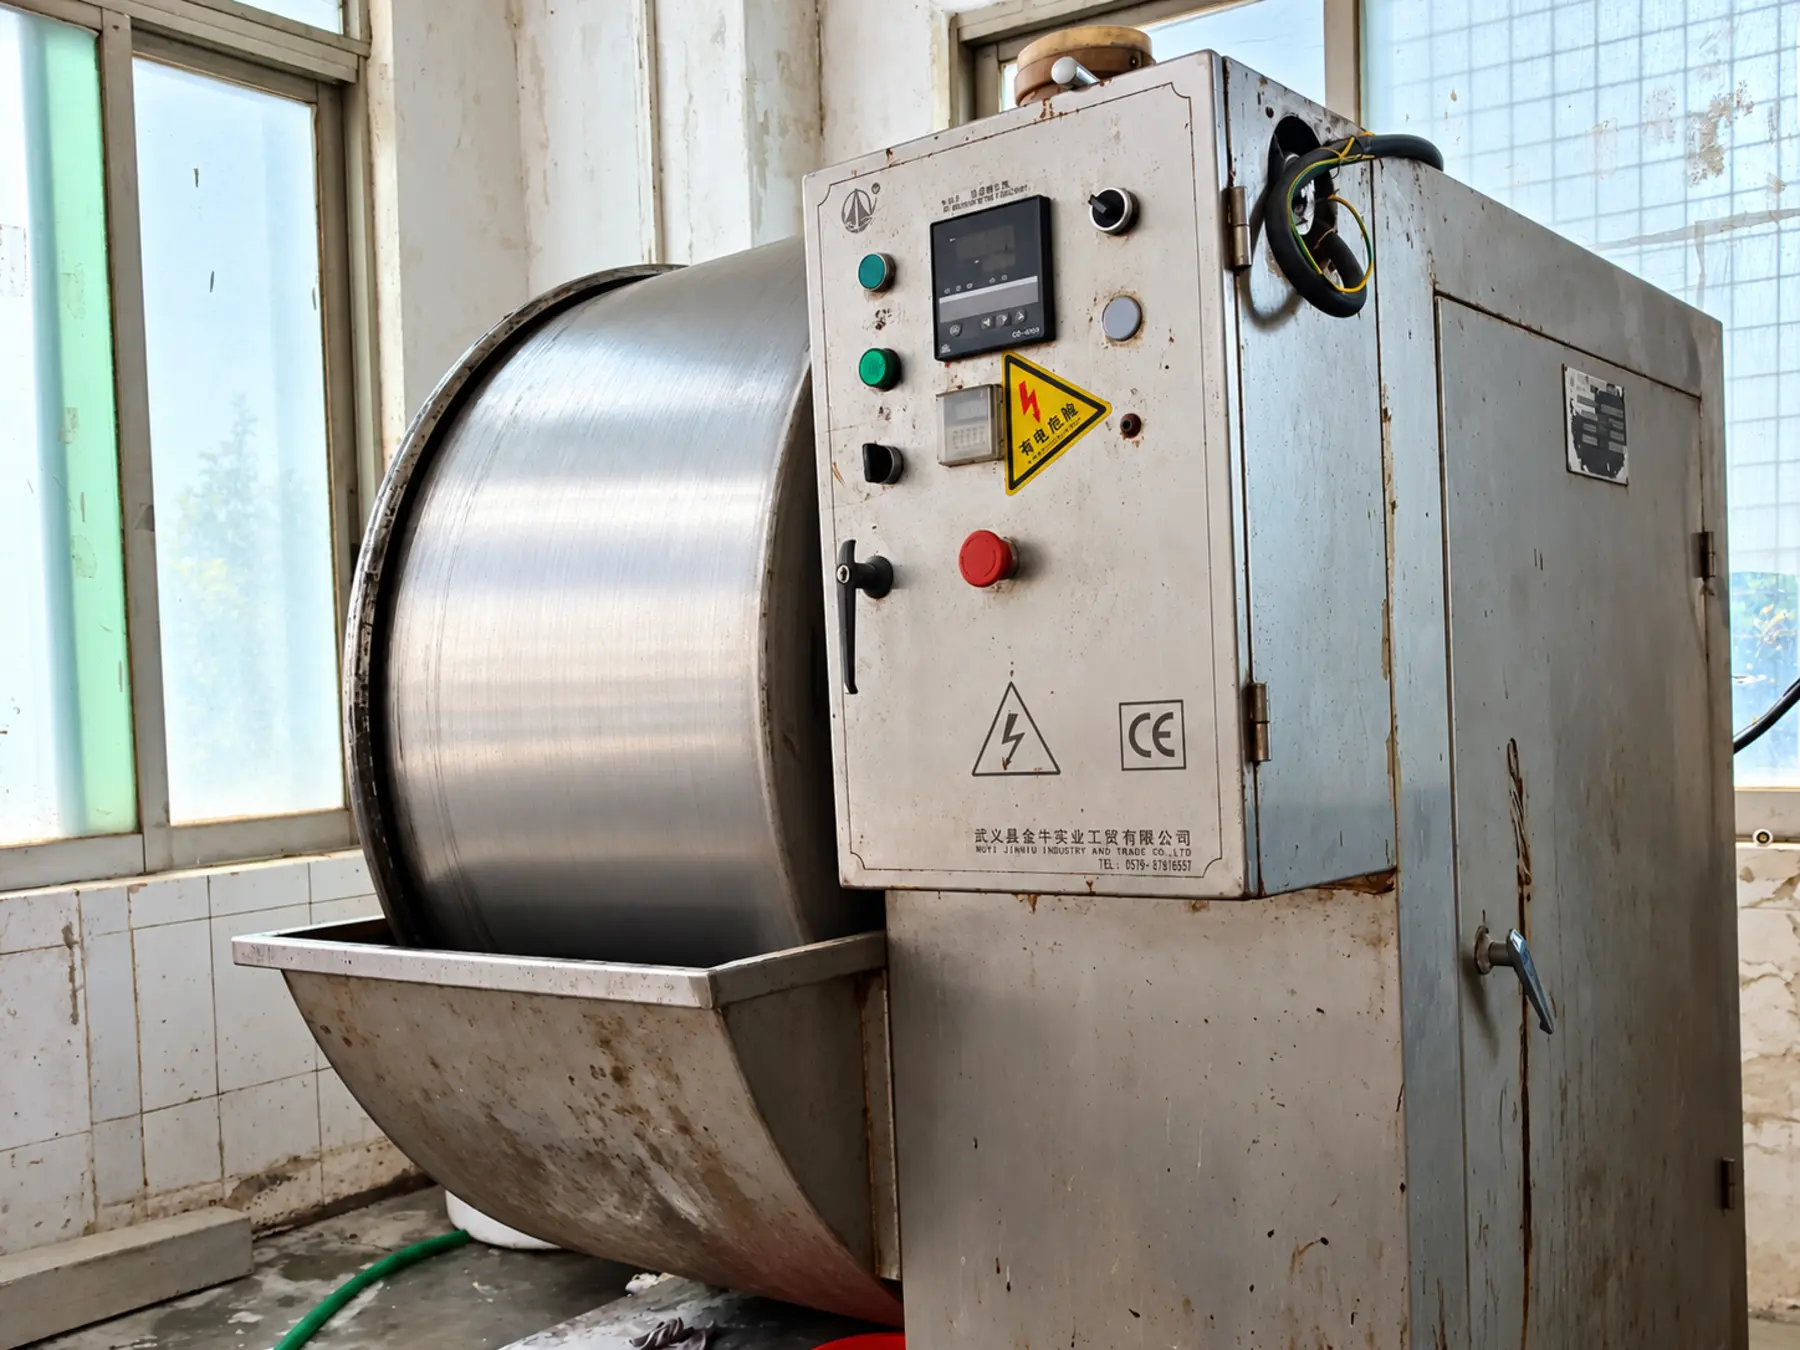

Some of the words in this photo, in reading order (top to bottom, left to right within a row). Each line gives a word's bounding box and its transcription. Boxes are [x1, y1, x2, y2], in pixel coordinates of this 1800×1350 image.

[1019, 403, 1079, 456] 有电危险
[1129, 712, 1175, 758] CE
[974, 828, 1192, 846] 武义县金牛实业工贸有限公司
[1043, 846, 1086, 855] INDUSTRY
[1092, 847, 1111, 856] AND
[1117, 847, 1146, 856] TRADE
